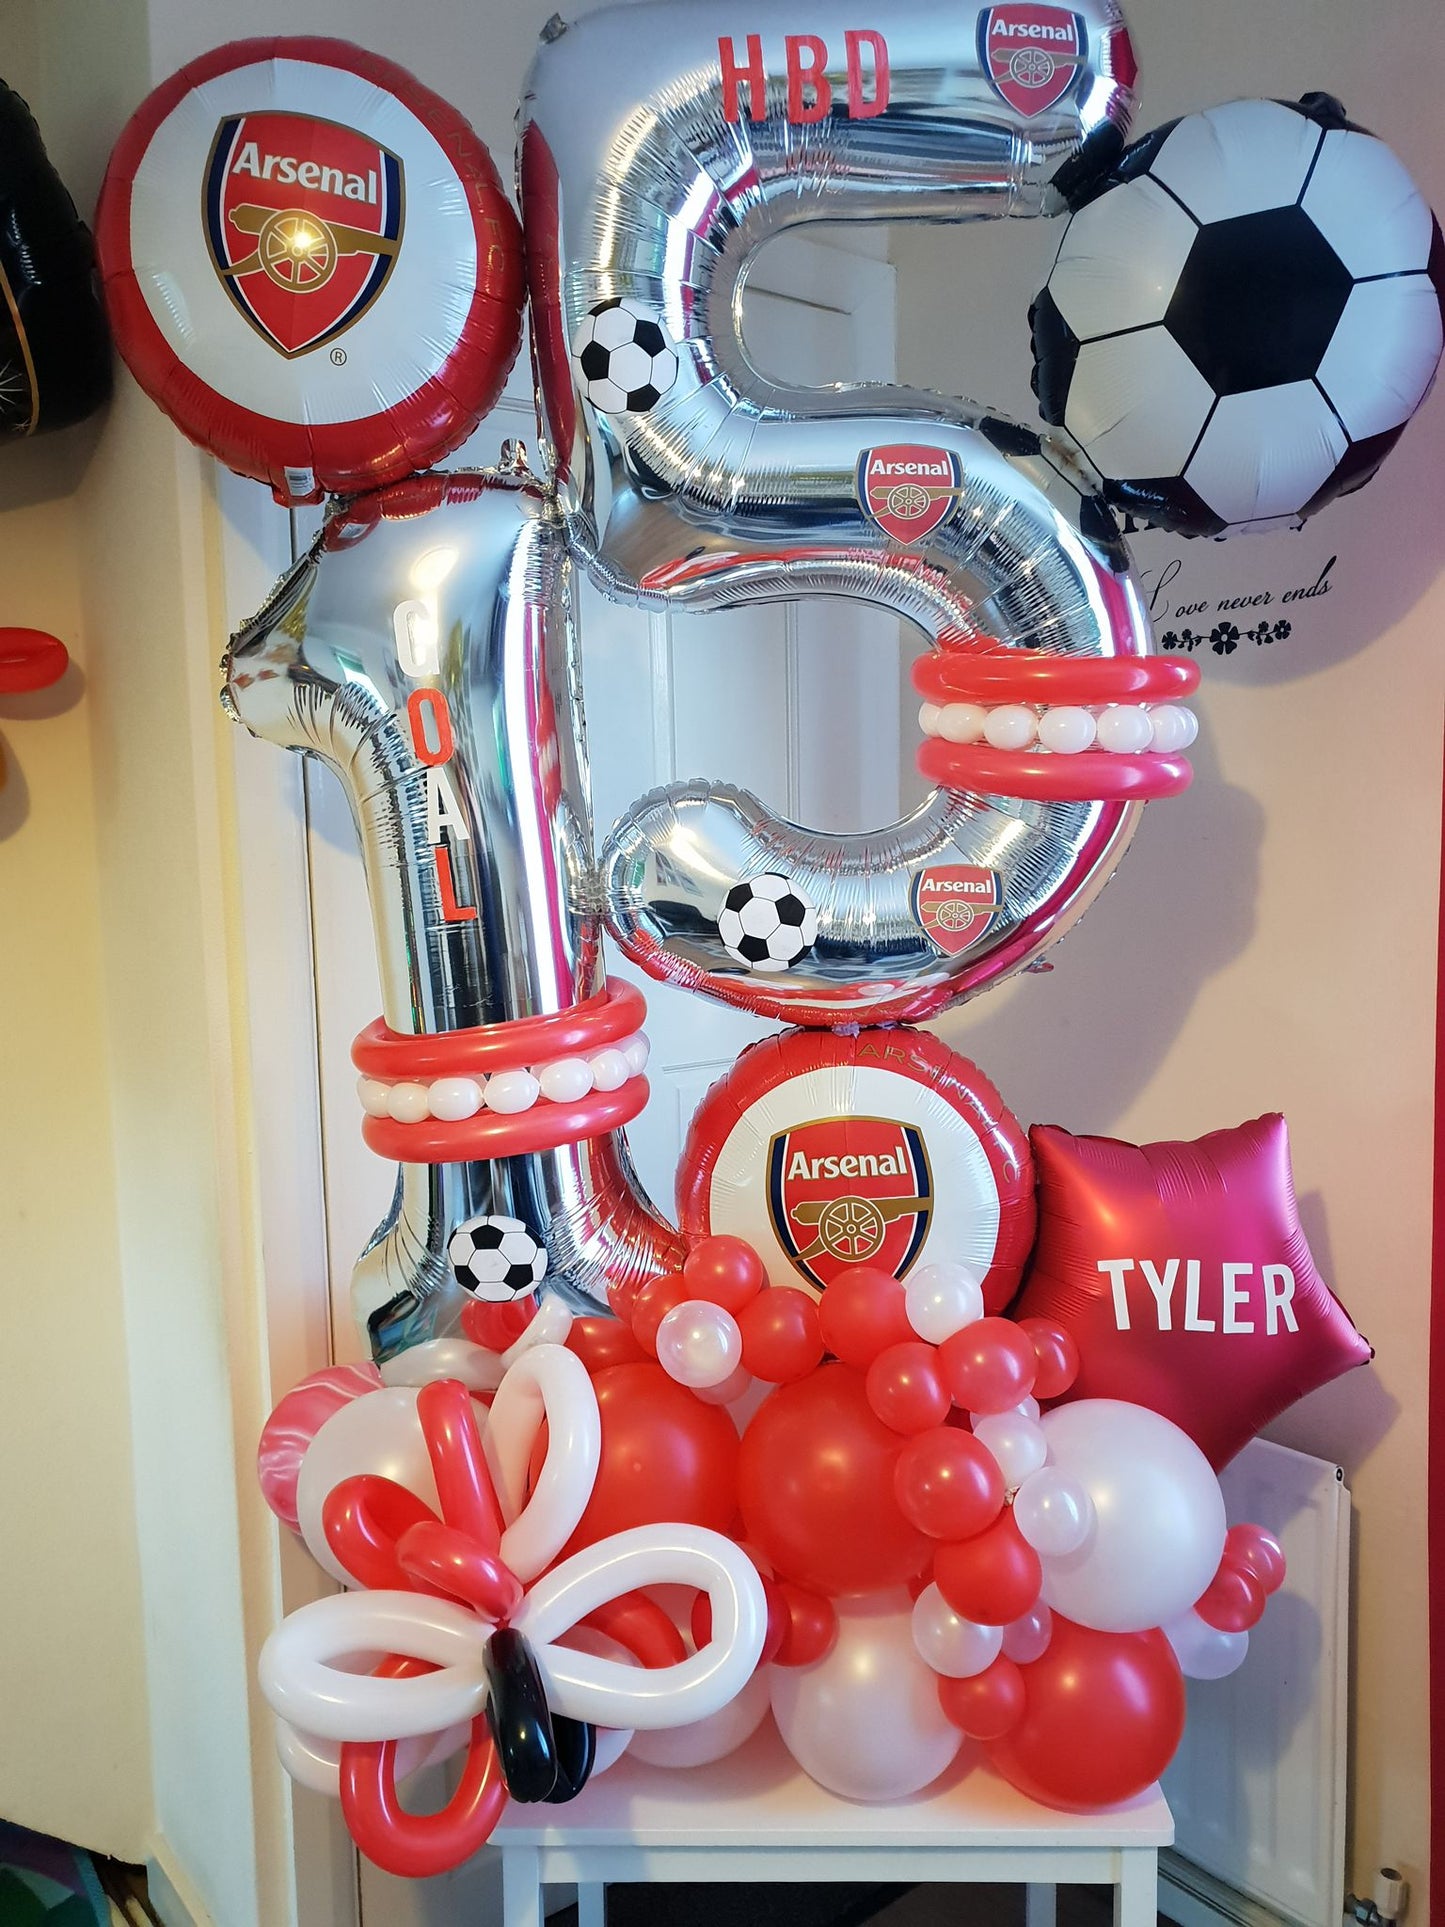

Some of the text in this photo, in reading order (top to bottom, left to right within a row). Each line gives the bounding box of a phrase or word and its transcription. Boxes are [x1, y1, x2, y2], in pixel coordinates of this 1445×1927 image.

[991, 19, 1074, 42] Arsenal
[717, 29, 891, 125] HBD
[232, 142, 378, 204] Arsenal
[869, 458, 950, 476] Arsenal
[1140, 555, 1337, 623] Love never ends
[393, 599, 477, 921] GOAL
[920, 878, 993, 894] Arsenal
[787, 1146, 908, 1181] Arsenal
[1097, 1258, 1300, 1336] TYLER
